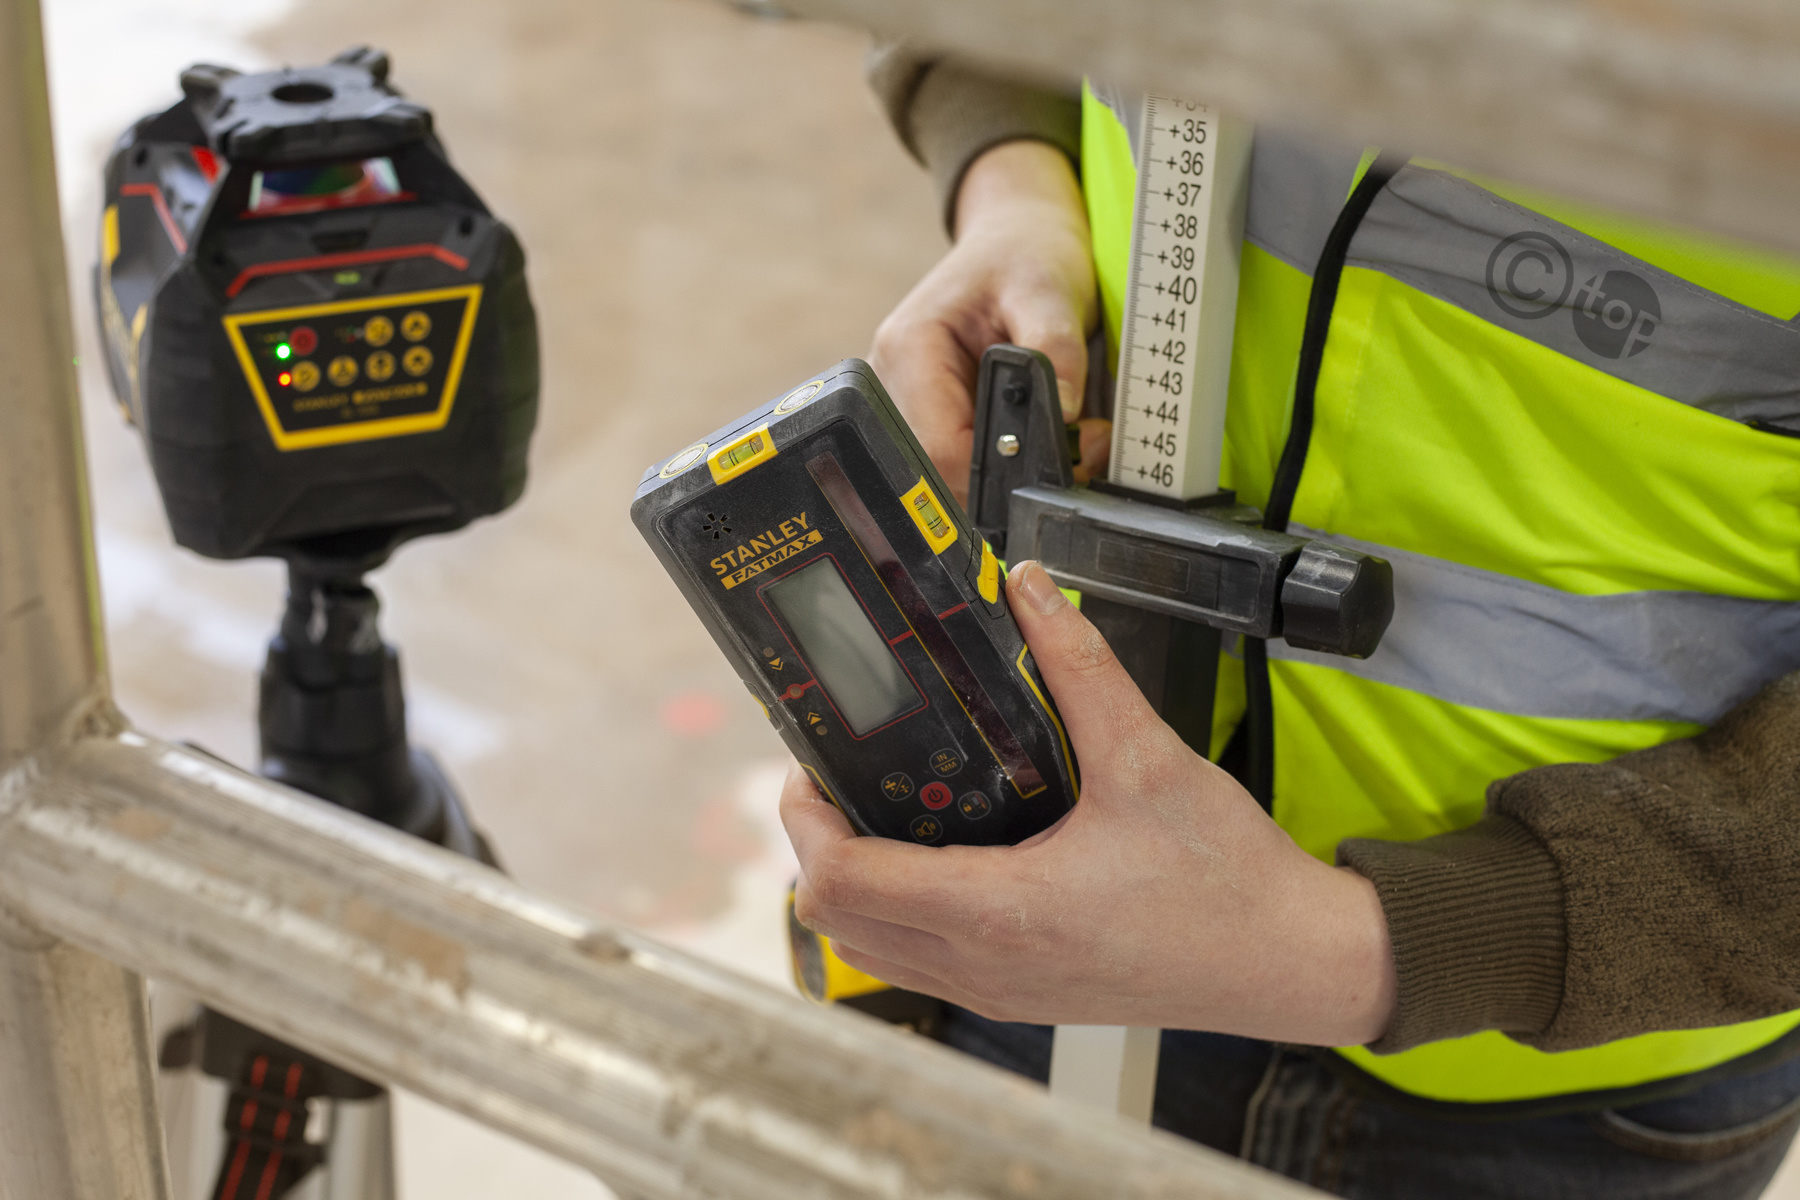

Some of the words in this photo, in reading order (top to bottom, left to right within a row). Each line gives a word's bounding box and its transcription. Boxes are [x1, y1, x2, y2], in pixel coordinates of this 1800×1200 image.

[1169, 119, 1207, 144] +35
[1166, 150, 1204, 176] +36
[1163, 182, 1202, 207] +37
[1160, 214, 1198, 239] +38
[1157, 245, 1195, 271] +39
[1154, 274, 1197, 305] +40
[1151, 308, 1186, 333] +41
[1148, 339, 1186, 365] +42
[1146, 370, 1183, 396] +43
[1143, 401, 1179, 426] +44
[1140, 431, 1176, 457] +45
[1137, 462, 1174, 488] +46
[710, 511, 809, 576] STANLEY
[936, 752, 948, 763] IN
[940, 761, 957, 773] MM
